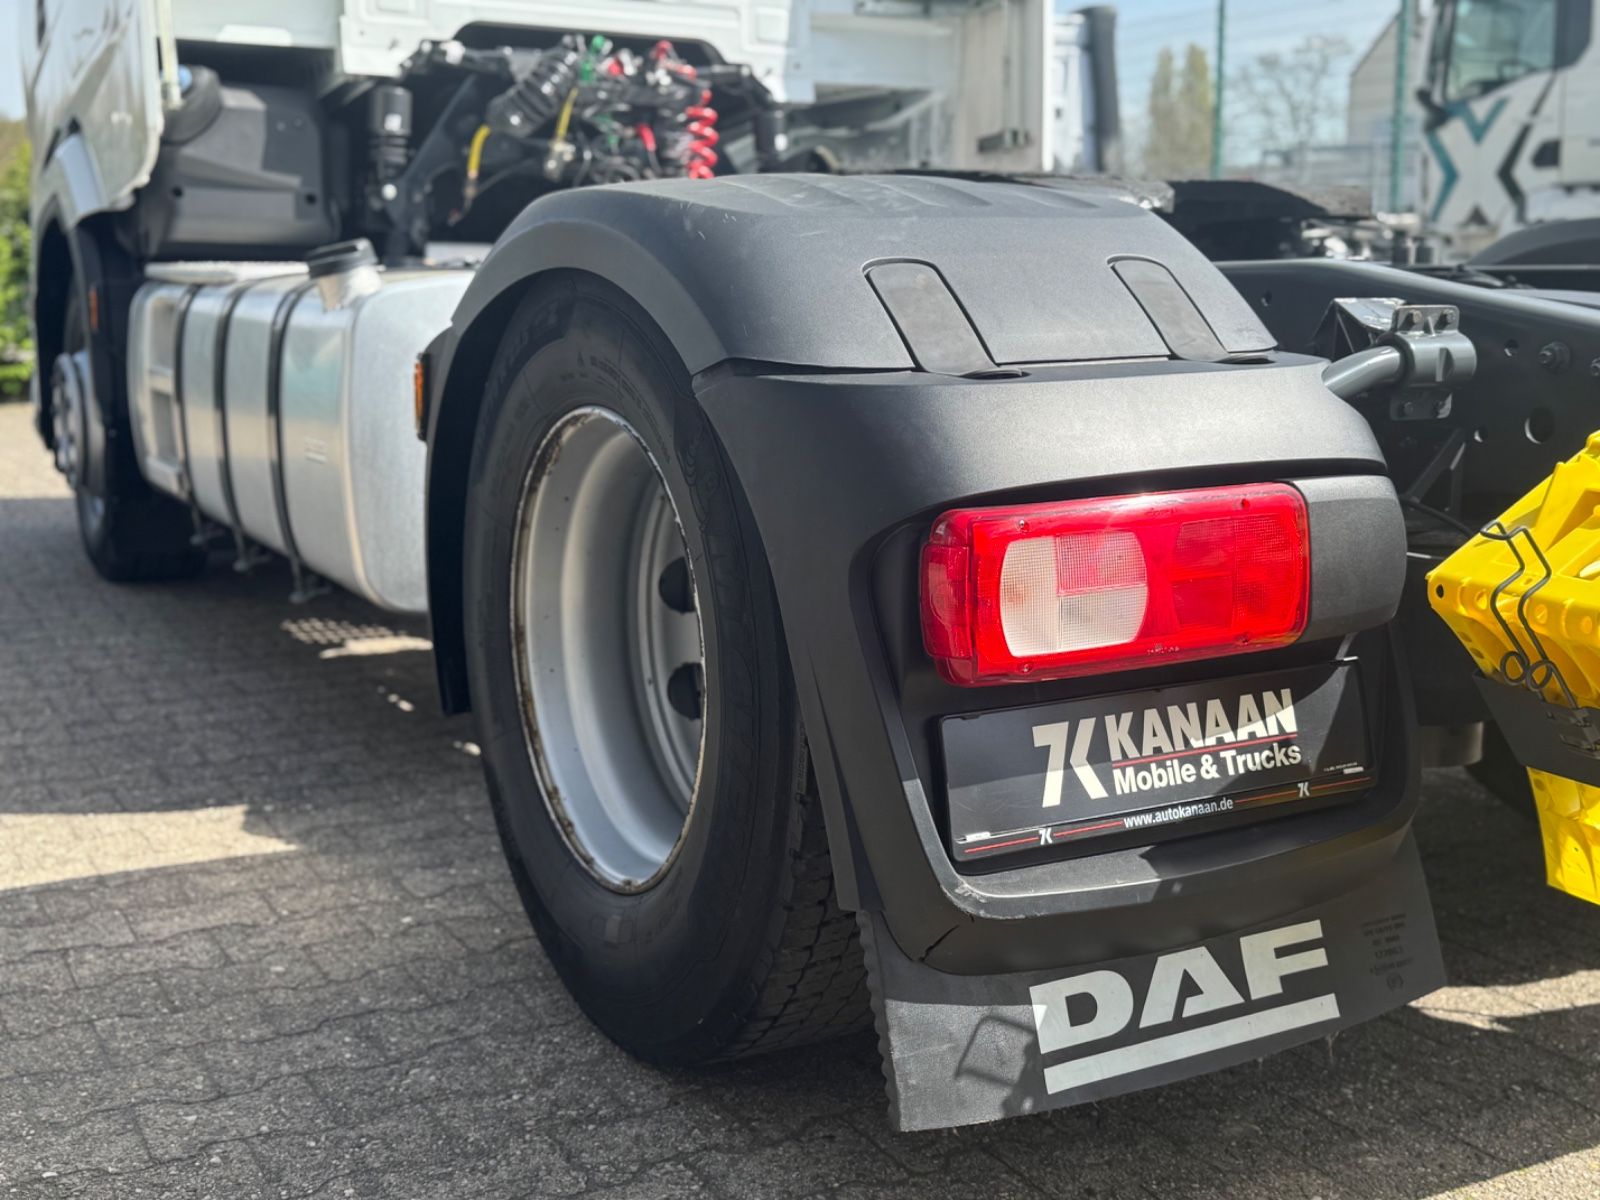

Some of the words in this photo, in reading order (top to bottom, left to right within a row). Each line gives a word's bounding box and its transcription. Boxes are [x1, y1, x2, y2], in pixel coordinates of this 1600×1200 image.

[1104, 688, 1298, 762] KANAAN
[1113, 757, 1196, 796] Mobile
[1200, 752, 1221, 780] &
[1220, 742, 1302, 777] Trucks
[1123, 796, 1234, 829] www.autokanaan.de
[1029, 919, 1329, 1054] DAF
